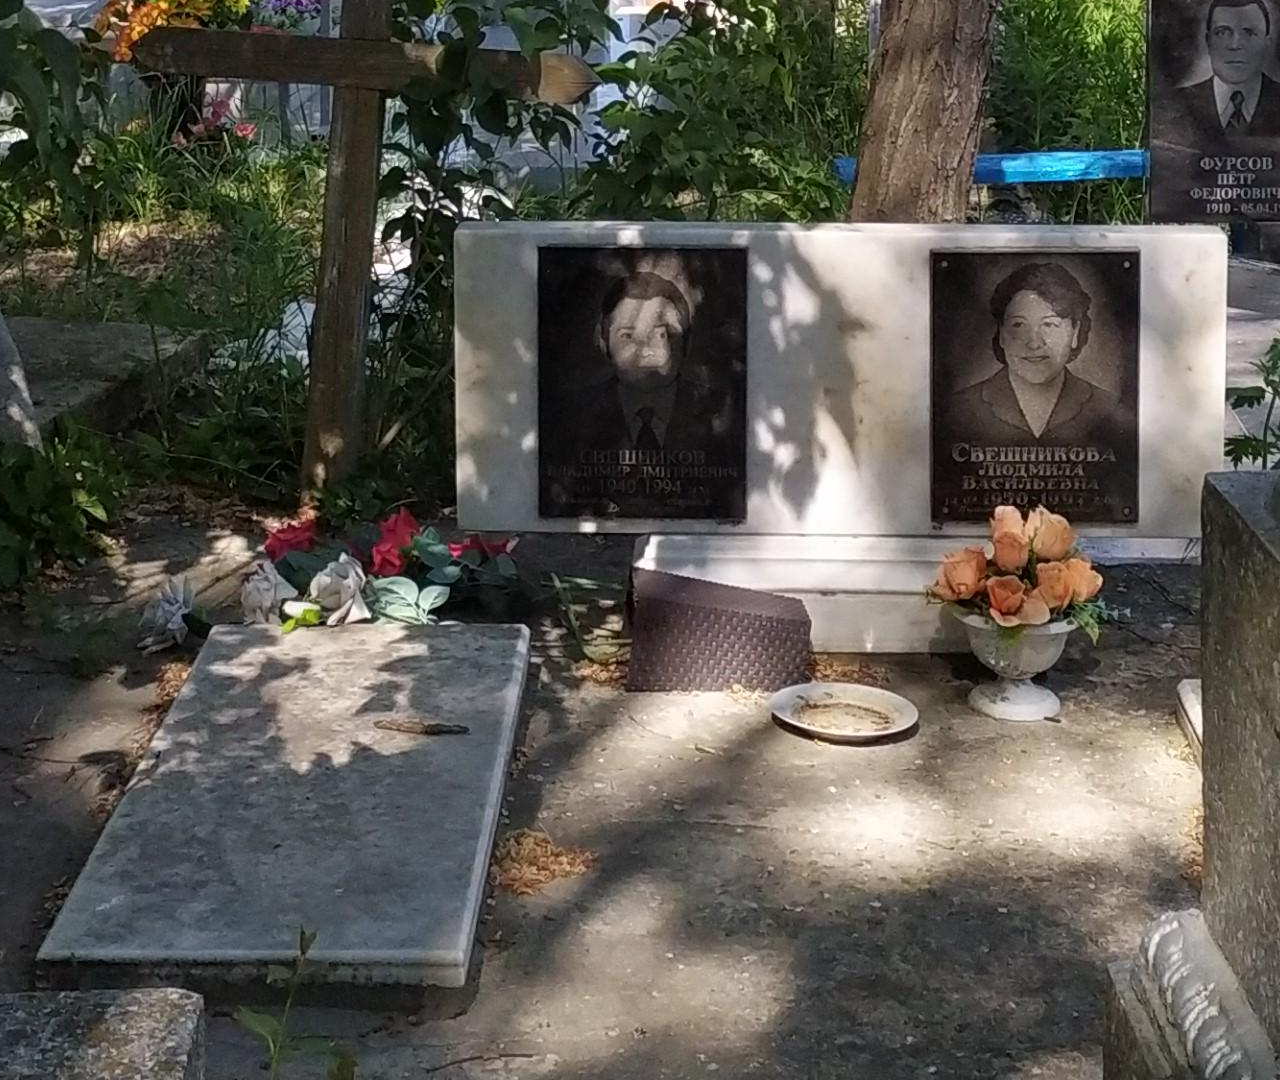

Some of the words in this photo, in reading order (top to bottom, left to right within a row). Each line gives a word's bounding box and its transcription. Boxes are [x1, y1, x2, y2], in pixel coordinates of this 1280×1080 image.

[1200, 156, 1273, 170] ФУРСОВ
[1217, 171, 1256, 185] ПЁТР
[951, 442, 1117, 463] СВЕШНИКОВА
[978, 462, 1085, 478] ЛЮДМИЛА
[962, 475, 1099, 491] ВАСИЛЬЕВНА
